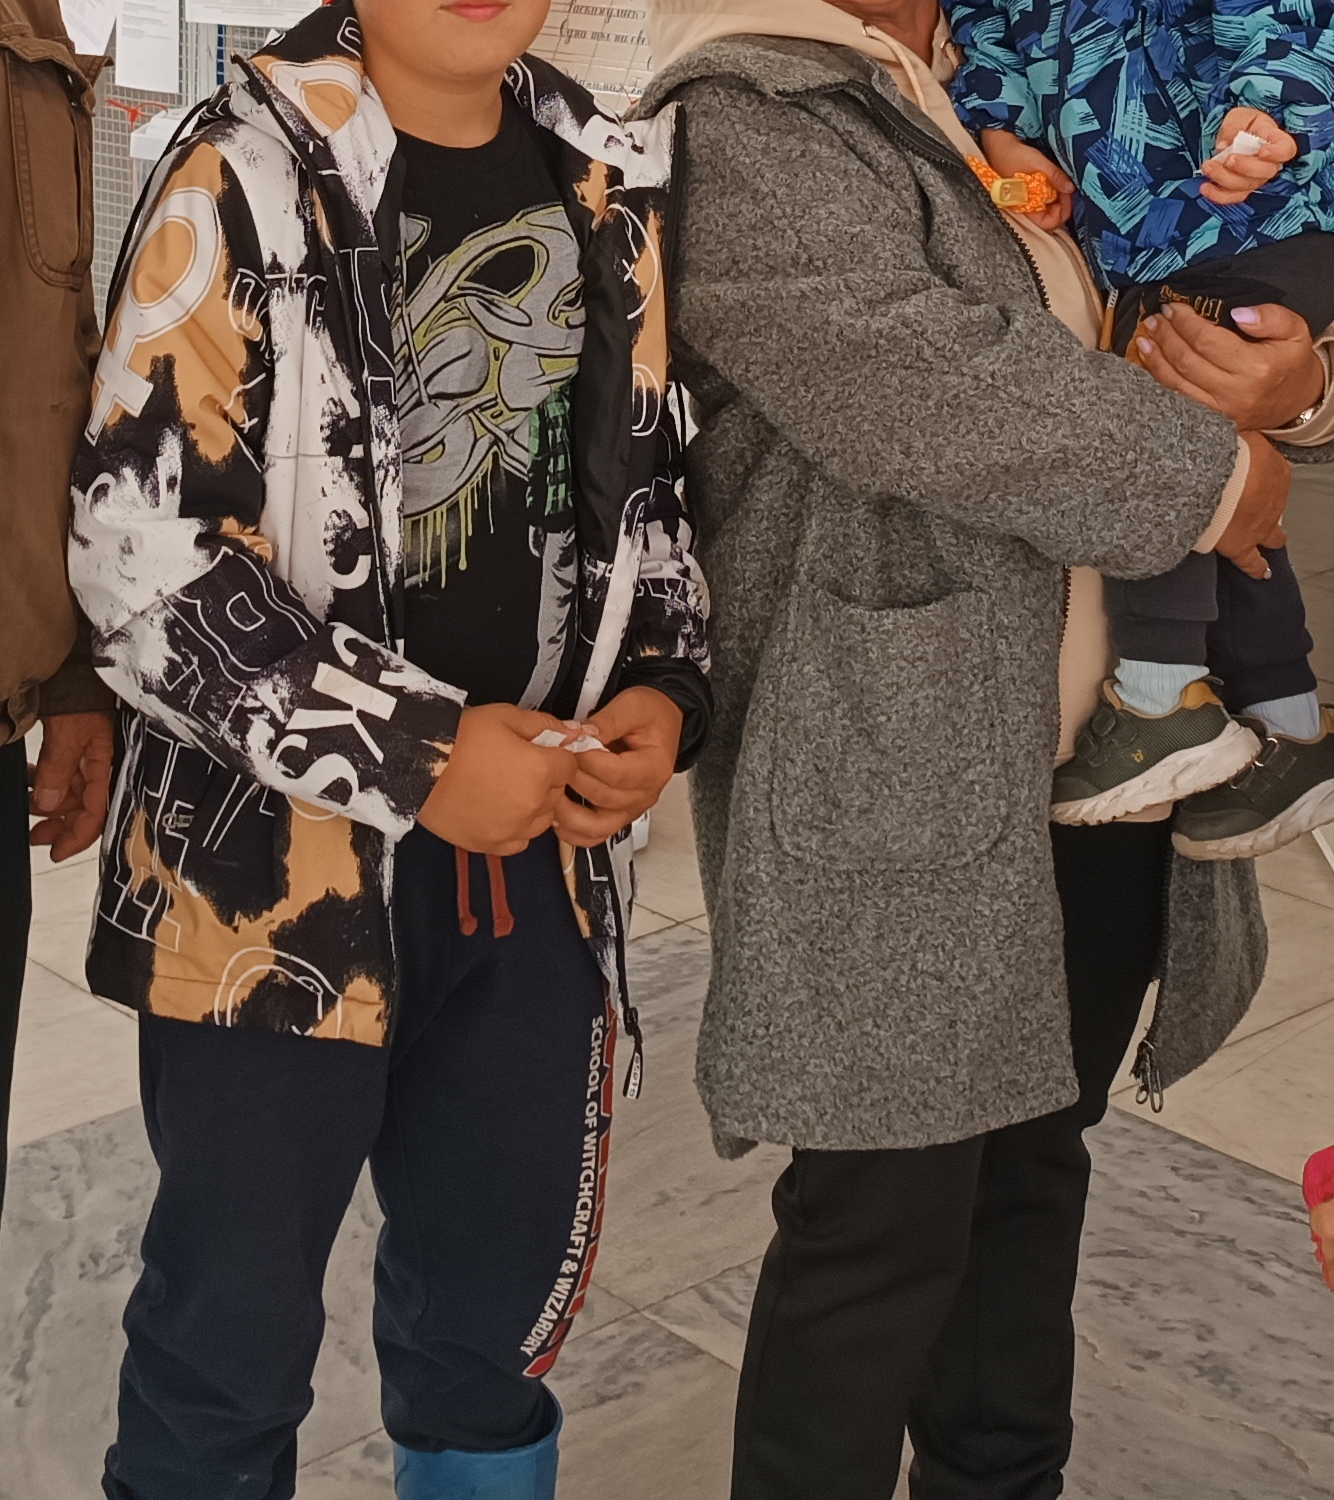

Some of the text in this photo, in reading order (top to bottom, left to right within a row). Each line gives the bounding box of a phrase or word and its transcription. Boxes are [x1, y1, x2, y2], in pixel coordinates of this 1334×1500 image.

[520, 1014, 605, 1358] SCHOOL OF WITCHCRAFT & WIZARDRY
